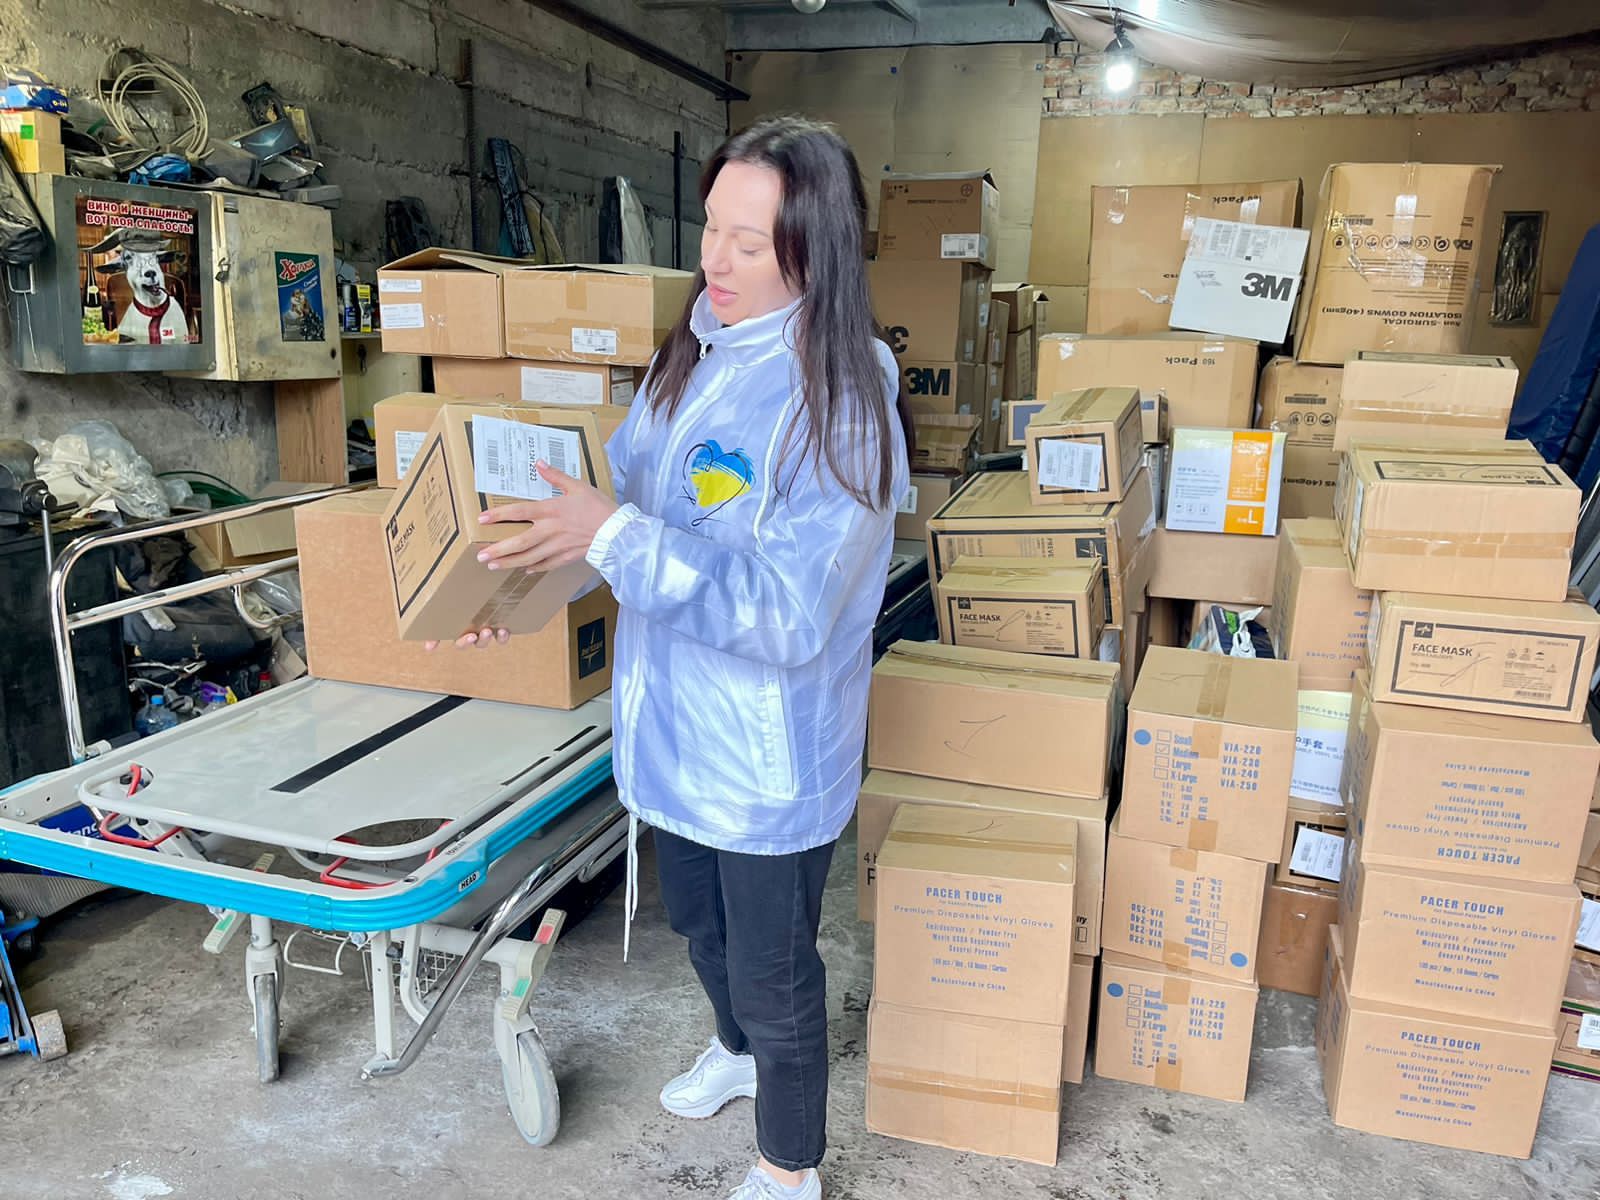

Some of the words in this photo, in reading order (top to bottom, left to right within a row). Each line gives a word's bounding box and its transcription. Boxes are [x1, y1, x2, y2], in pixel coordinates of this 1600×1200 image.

[87, 201, 117, 212] ВИНО
[120, 203, 128, 213] И
[86, 214, 107, 224] ВОТ
[110, 216, 134, 227] МОЯ
[137, 218, 194, 234] СЛАБОСТЬ!
[1240, 272, 1294, 302] 3M
[1322, 306, 1364, 315] (40gsm)
[1367, 309, 1406, 317] GOWNS
[1409, 311, 1462, 319] ISOLATION
[1165, 357, 1198, 365] Pack
[904, 367, 950, 396] 3M
[1248, 509, 1258, 524] L
[1412, 643, 1439, 653] FACE
[1440, 646, 1473, 656] MASK
[1224, 743, 1262, 755] VIA-220
[1172, 760, 1192, 771] Large
[1223, 755, 1260, 767] VIA-230
[1222, 767, 1258, 779] VIA-240
[1220, 779, 1257, 791] VIA-250
[1437, 847, 1477, 860] TOUCH
[1482, 852, 1520, 864] PACER
[461, 873, 477, 888] HEAD
[926, 887, 960, 900] PACER
[965, 891, 1002, 904] TOUCH
[1131, 904, 1164, 917] VIA-250
[1420, 895, 1458, 910] PACER
[1463, 901, 1504, 916] TOUCH
[894, 905, 934, 916] Premium
[993, 915, 1018, 925] Vinyl
[1383, 910, 1427, 922] Premium
[1491, 926, 1518, 937] Vinyl
[1191, 997, 1226, 1009] VIA-220
[1190, 1008, 1224, 1020] VIA-230
[1189, 1019, 1223, 1030] VIA-240
[1401, 1031, 1438, 1044] PACER
[1442, 1037, 1481, 1051] TOUCH
[1365, 1044, 1407, 1056] Premium
